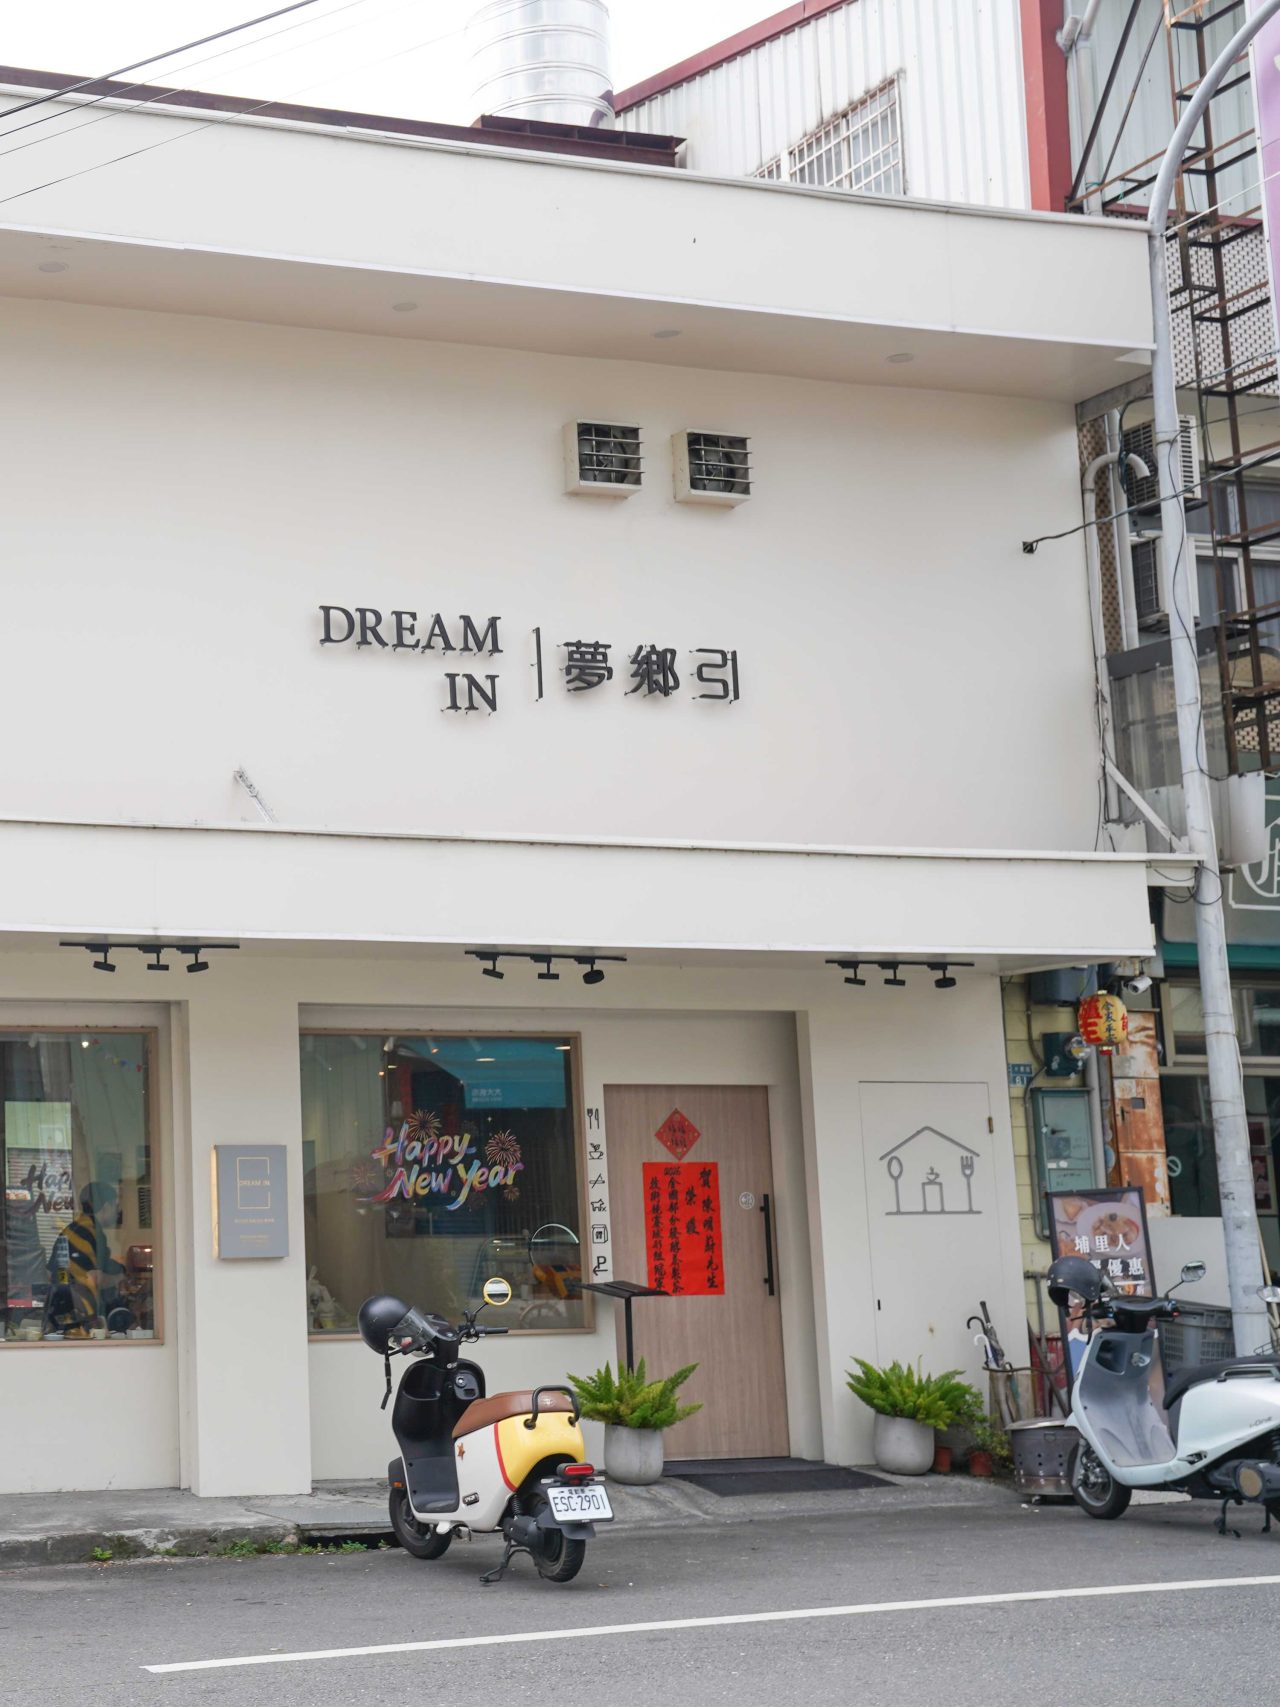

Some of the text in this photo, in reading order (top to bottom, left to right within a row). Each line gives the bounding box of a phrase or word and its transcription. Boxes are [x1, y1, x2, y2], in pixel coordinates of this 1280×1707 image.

[319, 605, 504, 655] DREAM
[442, 673, 500, 714] IN
[563, 640, 740, 702] 夢鄉引
[371, 1120, 477, 1167] Happy
[356, 1159, 525, 1211] New Year
[1074, 1234, 1131, 1253] 埔里人
